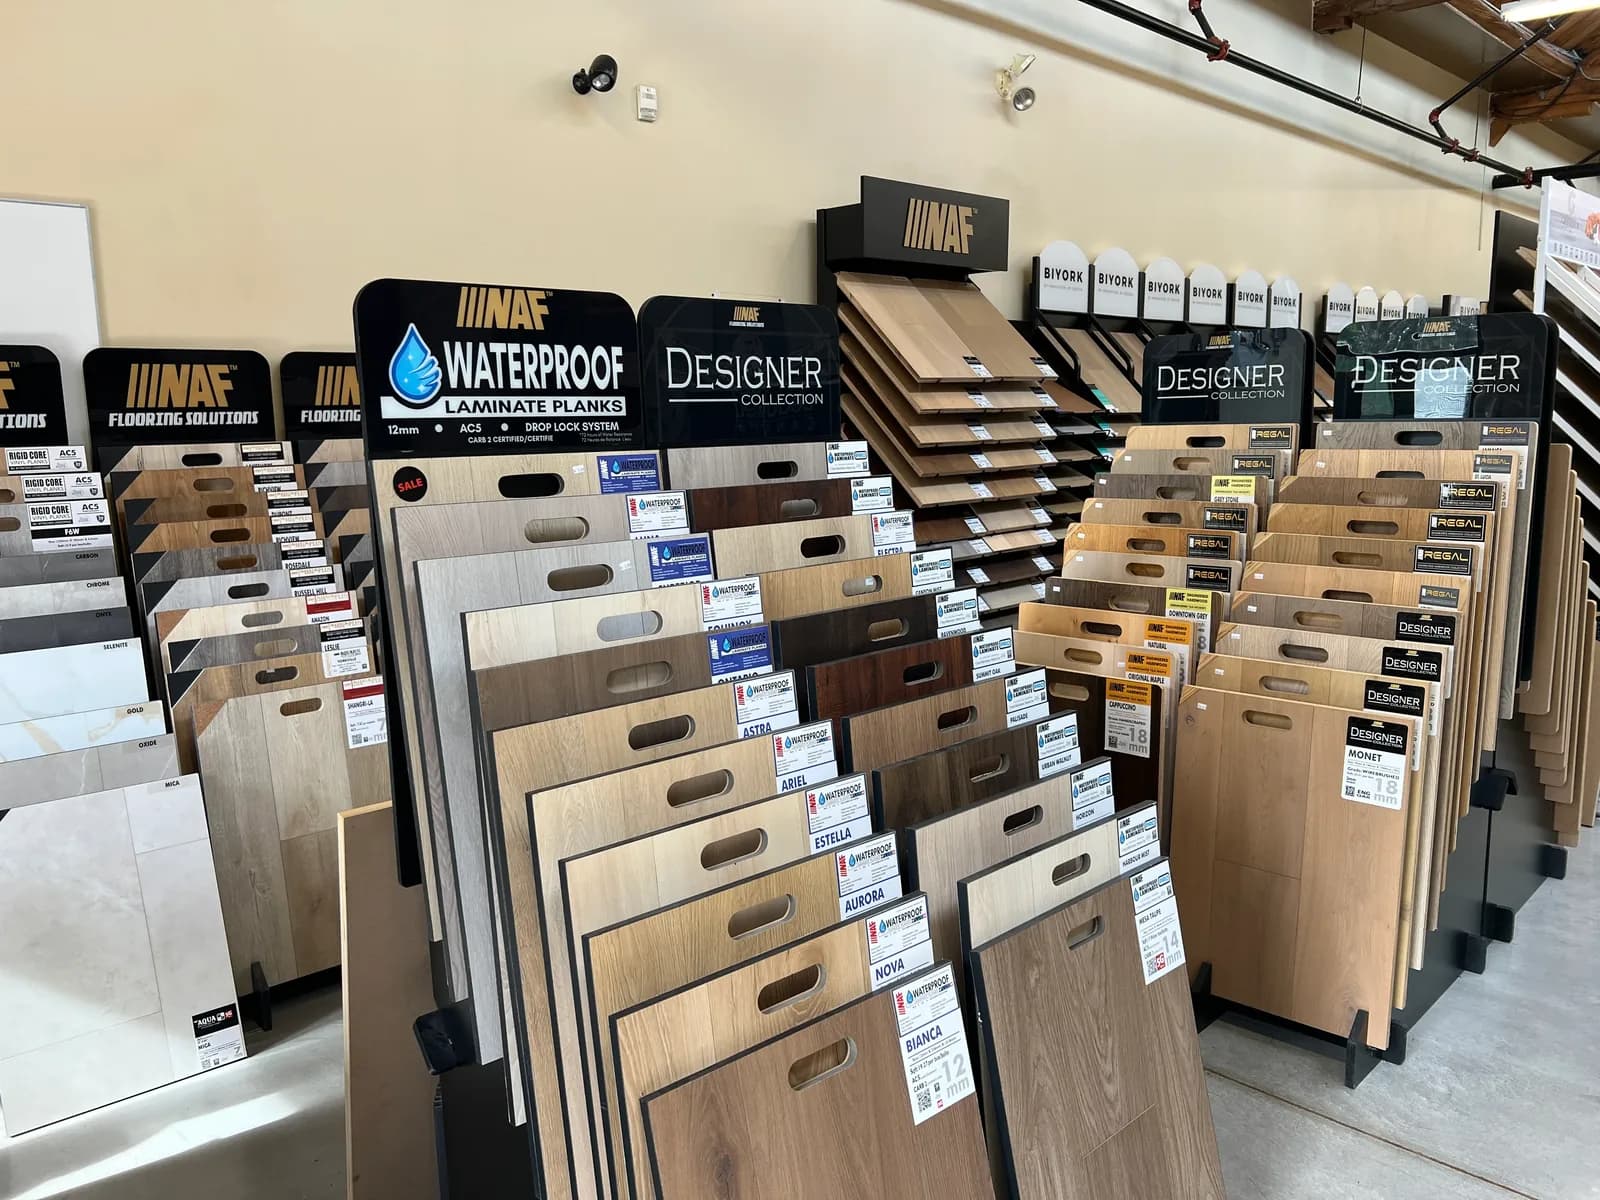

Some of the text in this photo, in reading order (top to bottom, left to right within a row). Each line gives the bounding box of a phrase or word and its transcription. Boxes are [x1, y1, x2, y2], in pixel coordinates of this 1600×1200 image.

[924, 200, 973, 254] NAF
[1044, 267, 1083, 283] BIYORK
[1099, 272, 1134, 289] BIYORK
[1148, 281, 1180, 295] BIYORK
[1192, 287, 1222, 300] BIYORK
[1238, 290, 1264, 304] BIYORK
[1273, 295, 1297, 307] BIYORK
[484, 288, 549, 331] NAF
[1329, 301, 1351, 312] BIYORK
[1357, 306, 1376, 315] BIYORK
[1383, 308, 1401, 317] BIYORK
[443, 341, 623, 390] WATERPROOF
[666, 347, 822, 389] DESIGNER
[1353, 354, 1520, 383] DESIGNER
[1157, 364, 1285, 391] DESIGNER
[158, 364, 234, 407] NAF
[1424, 384, 1520, 394] COLLECTION
[741, 394, 823, 405] COLLECTION
[1211, 390, 1285, 400] COLLECTION
[445, 399, 622, 414] LAMINATE PLANKS
[109, 411, 259, 427] FLOORING SOLUTIONS
[387, 424, 419, 435] 12mm
[460, 424, 482, 434] AC5
[525, 421, 620, 432] DROP LOCK SYSTEM
[1489, 427, 1527, 435] REGAL
[468, 436, 486, 444] CARB
[9, 450, 47, 460] RIGID CORE
[1239, 460, 1272, 468] REGAL
[25, 478, 63, 487] RIGID CORE
[398, 478, 423, 492] SALE
[1450, 488, 1492, 497] REGAL
[645, 498, 680, 508] WATERPROOF
[31, 506, 69, 515] RIGID CORE
[1211, 512, 1245, 521] REGAL
[1438, 518, 1482, 528] REGAL
[1194, 539, 1228, 549] REGAL
[1424, 551, 1469, 561] REGAL
[1194, 570, 1228, 580] REGAL
[294, 588, 315, 596] RUSSELL
[719, 583, 755, 594] WATERPROOF
[1426, 589, 1457, 599] REGAL
[1169, 610, 1195, 619] DOWNTOWN
[1399, 622, 1451, 636] DESIGNER
[103, 642, 128, 650] SELENITE
[324, 643, 340, 651] LESLIE
[1385, 657, 1438, 672] DESIGNER
[975, 669, 992, 679] SUMMIT
[1128, 673, 1165, 684] ORIGINAL MAPLE
[752, 679, 789, 694] WATERPROOF
[1013, 688, 1033, 697] LAMINATE
[1368, 690, 1420, 706] DESIGNER
[347, 700, 373, 709] SHANGRI-LA
[1109, 701, 1136, 711] CAPPUCCINO
[127, 707, 144, 715] GOLD
[1010, 713, 1028, 723] PALISADE
[743, 722, 772, 738] ASTRA
[791, 729, 827, 744] WATERPROOF
[1044, 734, 1064, 744] LAMINATE
[1130, 728, 1147, 744] 18
[1350, 727, 1403, 745] DESIGNER
[138, 740, 157, 748] OXIDE
[1129, 743, 1148, 754] mm
[1349, 750, 1382, 762] MONET
[1041, 760, 1056, 770] URBAN
[165, 780, 180, 788] MICA
[781, 775, 807, 791] ARIEL
[1079, 783, 1099, 793] LAMINATE
[1376, 778, 1398, 795] 18
[825, 783, 861, 800] WATERPROOF
[1374, 794, 1397, 805] mm
[1075, 808, 1095, 821] HORIZON
[815, 828, 852, 849] ESTELLA
[1126, 828, 1145, 839] LAMINATE
[855, 842, 892, 862] WATERPROOF
[1122, 854, 1140, 867] HARBOUR
[1140, 884, 1158, 897] LAMINATE
[845, 888, 885, 913] AURORA
[885, 905, 923, 928] WATERPROOF
[1162, 930, 1179, 954] 14
[1166, 951, 1182, 966] mm
[875, 958, 905, 980] NOVA
[912, 975, 949, 998] WATERPROOF
[198, 1016, 216, 1025] AQUA
[906, 1025, 943, 1053] BIANCA
[198, 1042, 211, 1050] MICA
[942, 1054, 967, 1082] 12
[947, 1077, 970, 1098] mm
